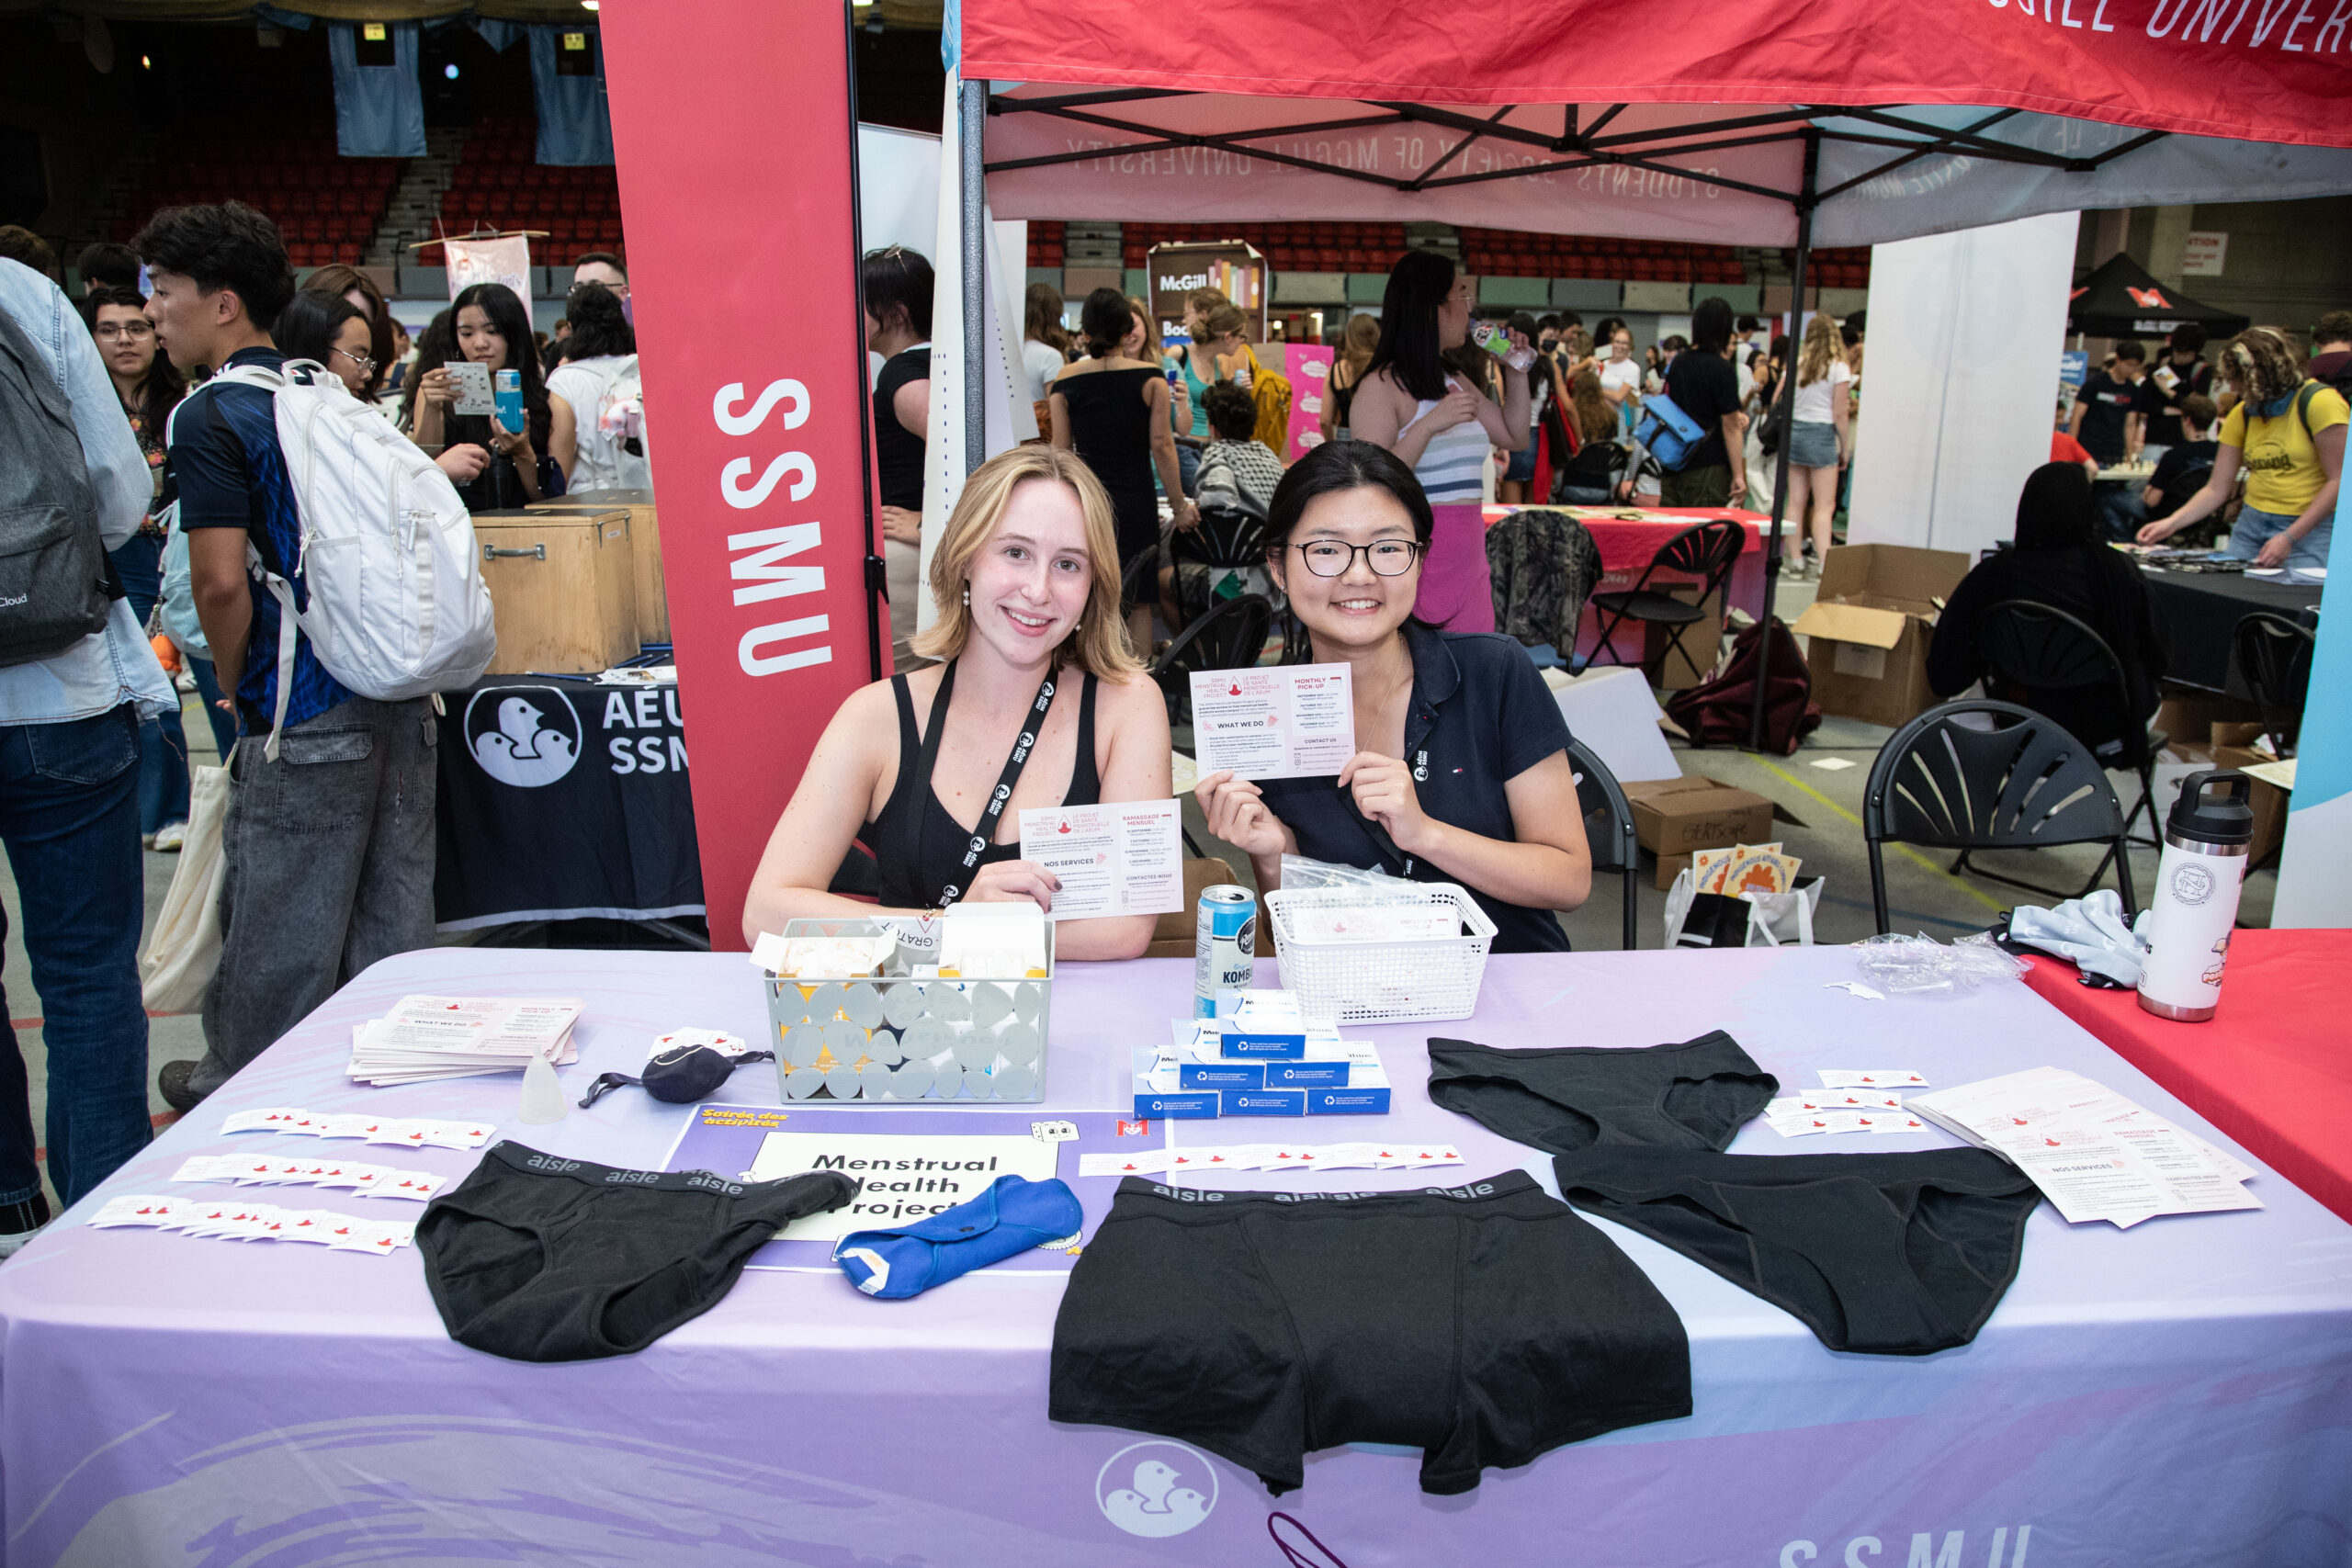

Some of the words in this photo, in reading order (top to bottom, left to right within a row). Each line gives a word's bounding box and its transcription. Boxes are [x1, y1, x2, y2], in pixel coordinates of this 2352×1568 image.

[2145, 0, 2352, 53] UNIVER
[1159, 274, 1207, 291] McGill
[713, 378, 832, 677] SSMU
[603, 684, 684, 728] AÉU
[609, 736, 689, 774] SSM
[1060, 858, 1094, 866] SERVICES
[881, 922, 933, 947] GRATT
[702, 1109, 755, 1119] Soirée
[758, 1111, 789, 1121] des
[703, 1117, 780, 1128] activités
[527, 1155, 581, 1171] aisle
[812, 1155, 998, 1171] Menstrual
[2073, 1162, 2113, 1171] SERVICES
[605, 1170, 660, 1184] aisle
[686, 1176, 743, 1194] aisle
[1153, 1182, 1225, 1202] aisle
[1273, 1191, 1326, 1202] aisl
[1425, 1182, 1495, 1199] aisle
[828, 1199, 956, 1219] rojec
